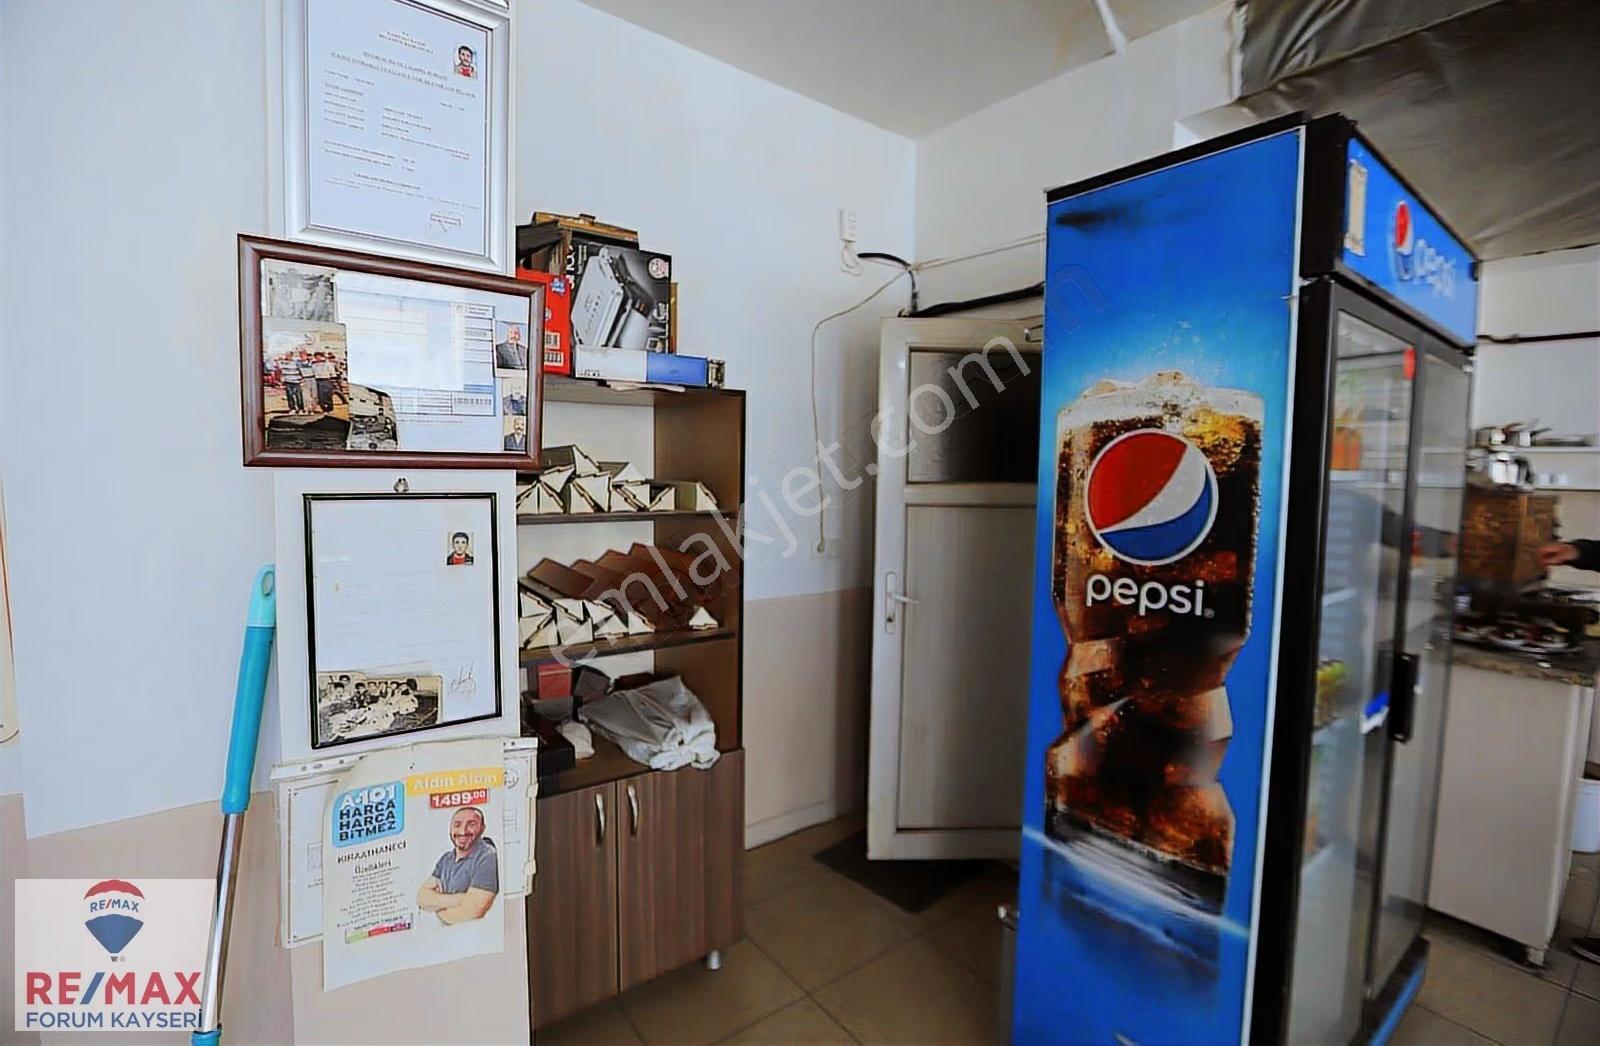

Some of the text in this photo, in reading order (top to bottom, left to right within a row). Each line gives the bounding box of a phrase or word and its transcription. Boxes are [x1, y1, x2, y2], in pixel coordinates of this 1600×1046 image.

[1086, 573, 1205, 617] pepsi
[339, 799, 396, 820] HARCA
[339, 810, 396, 831] HARCA
